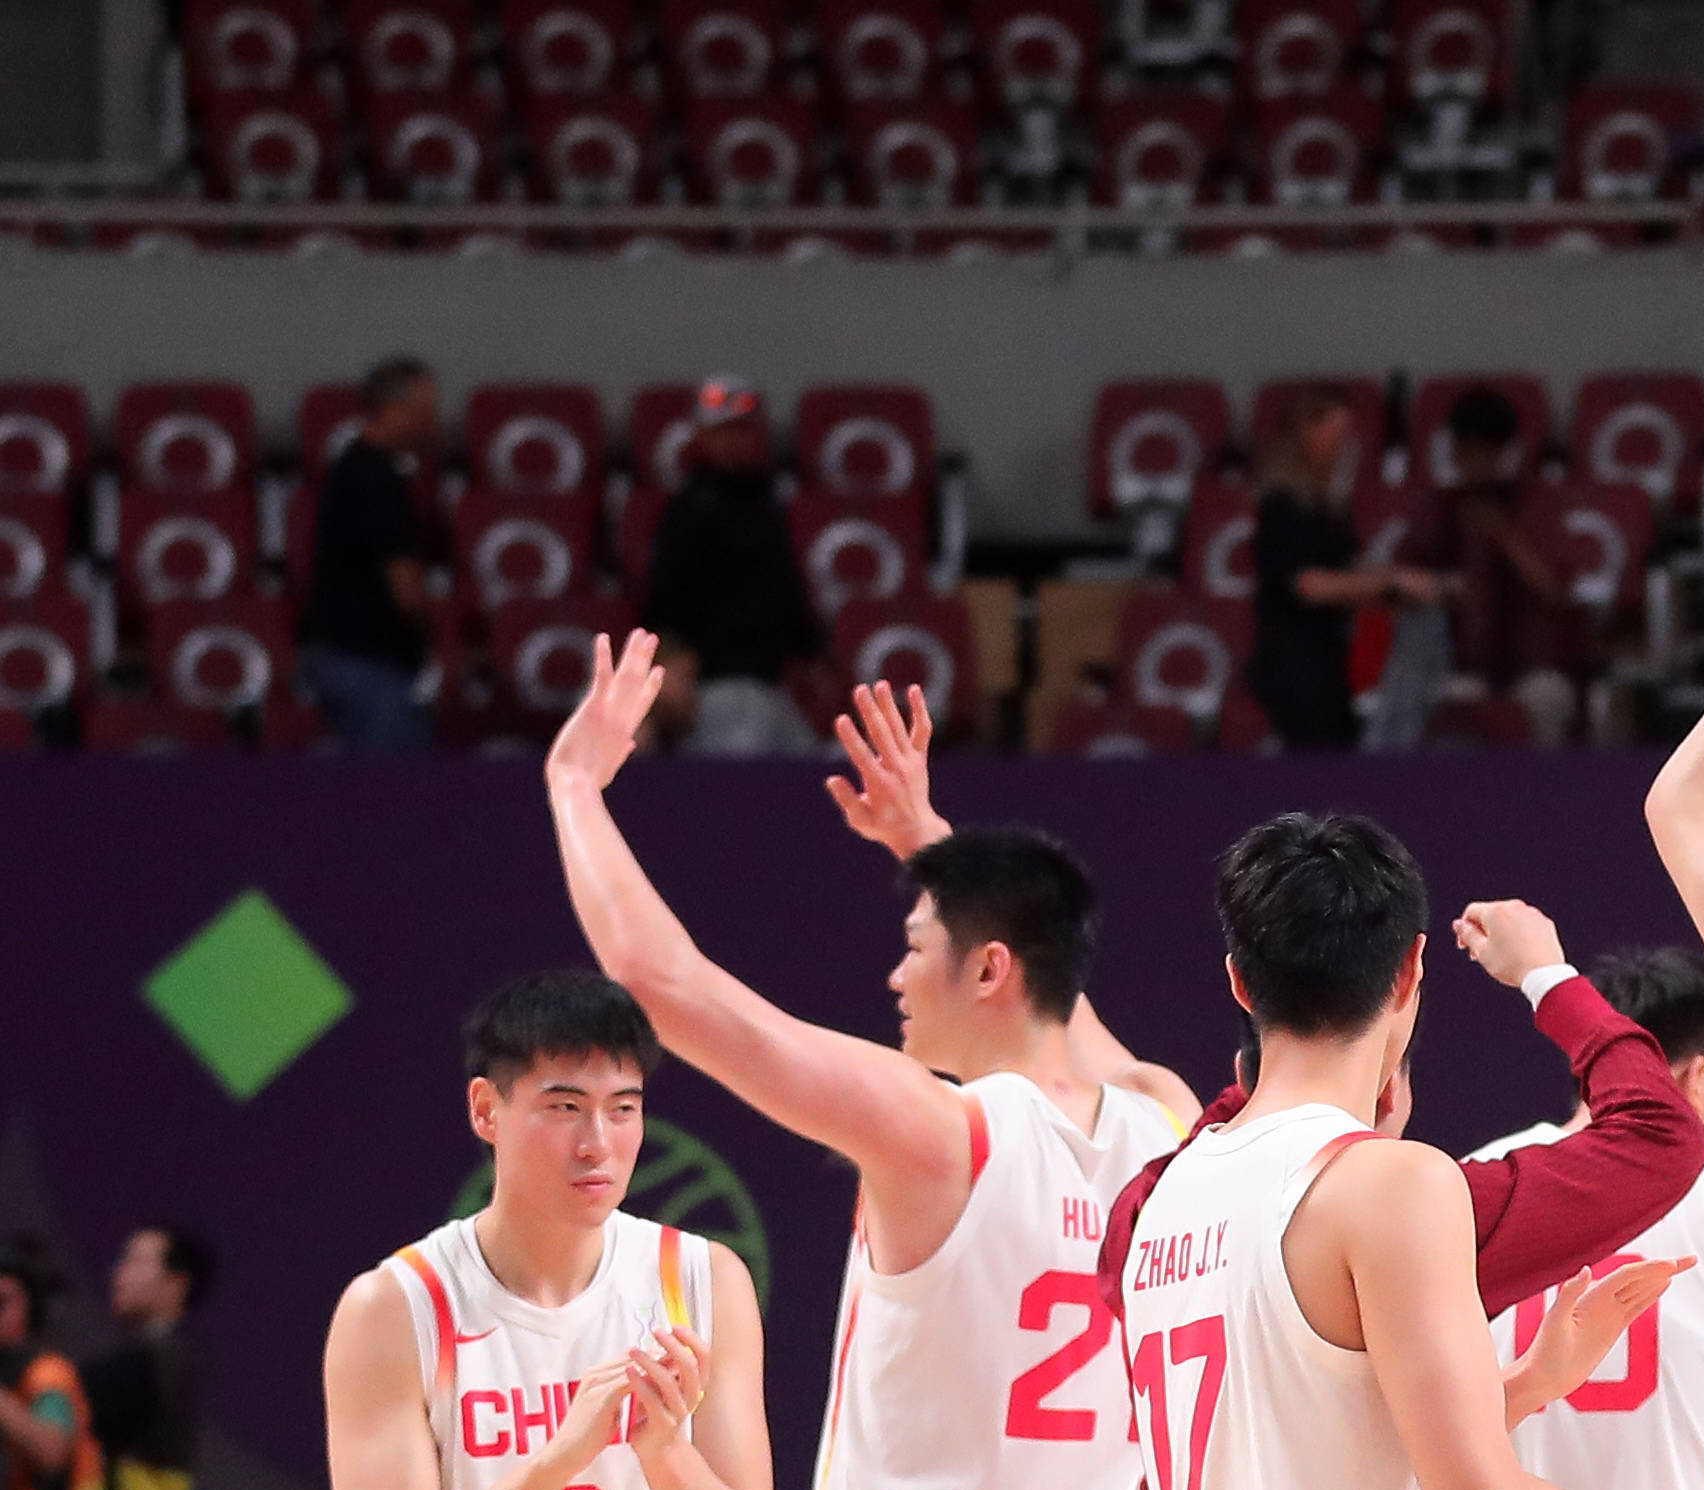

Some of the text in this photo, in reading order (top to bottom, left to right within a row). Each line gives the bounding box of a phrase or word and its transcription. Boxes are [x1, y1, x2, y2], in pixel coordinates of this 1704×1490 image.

[1062, 1196, 1101, 1241] HU
[1134, 1219, 1228, 1292] ZHAO J.Y.
